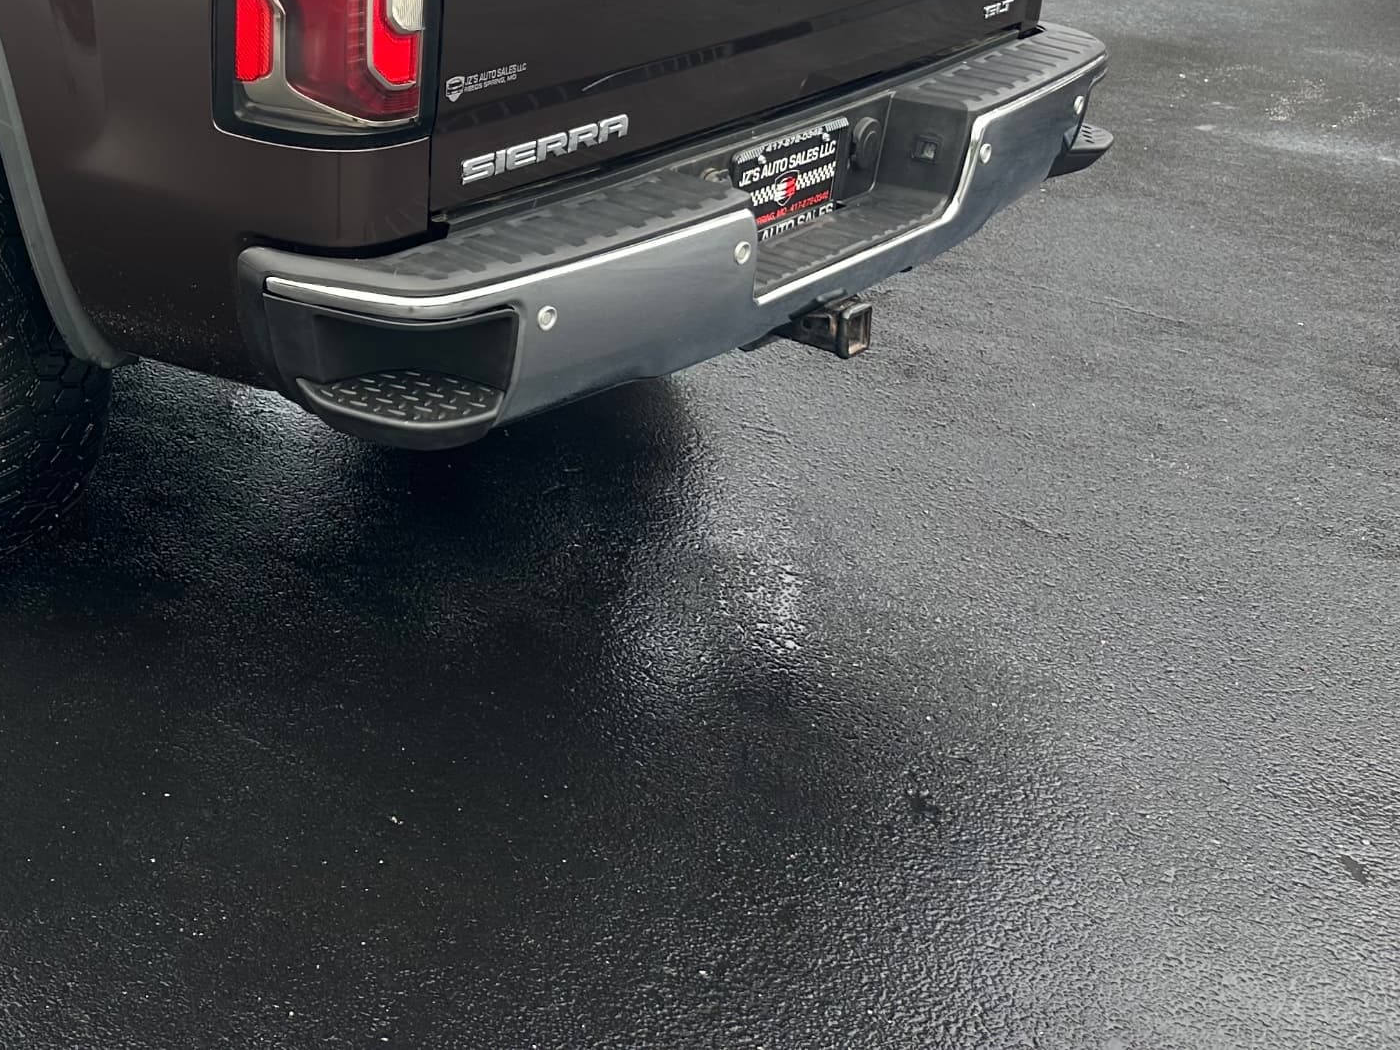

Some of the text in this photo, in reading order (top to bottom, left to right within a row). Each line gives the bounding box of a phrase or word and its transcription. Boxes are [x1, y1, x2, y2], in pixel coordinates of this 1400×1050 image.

[479, 69, 497, 82] AUTO
[497, 64, 517, 78] SALES
[517, 62, 527, 72] LLC
[460, 113, 629, 186] SIERRA
[738, 140, 837, 188] JZ'S AUTO SALES LLC
